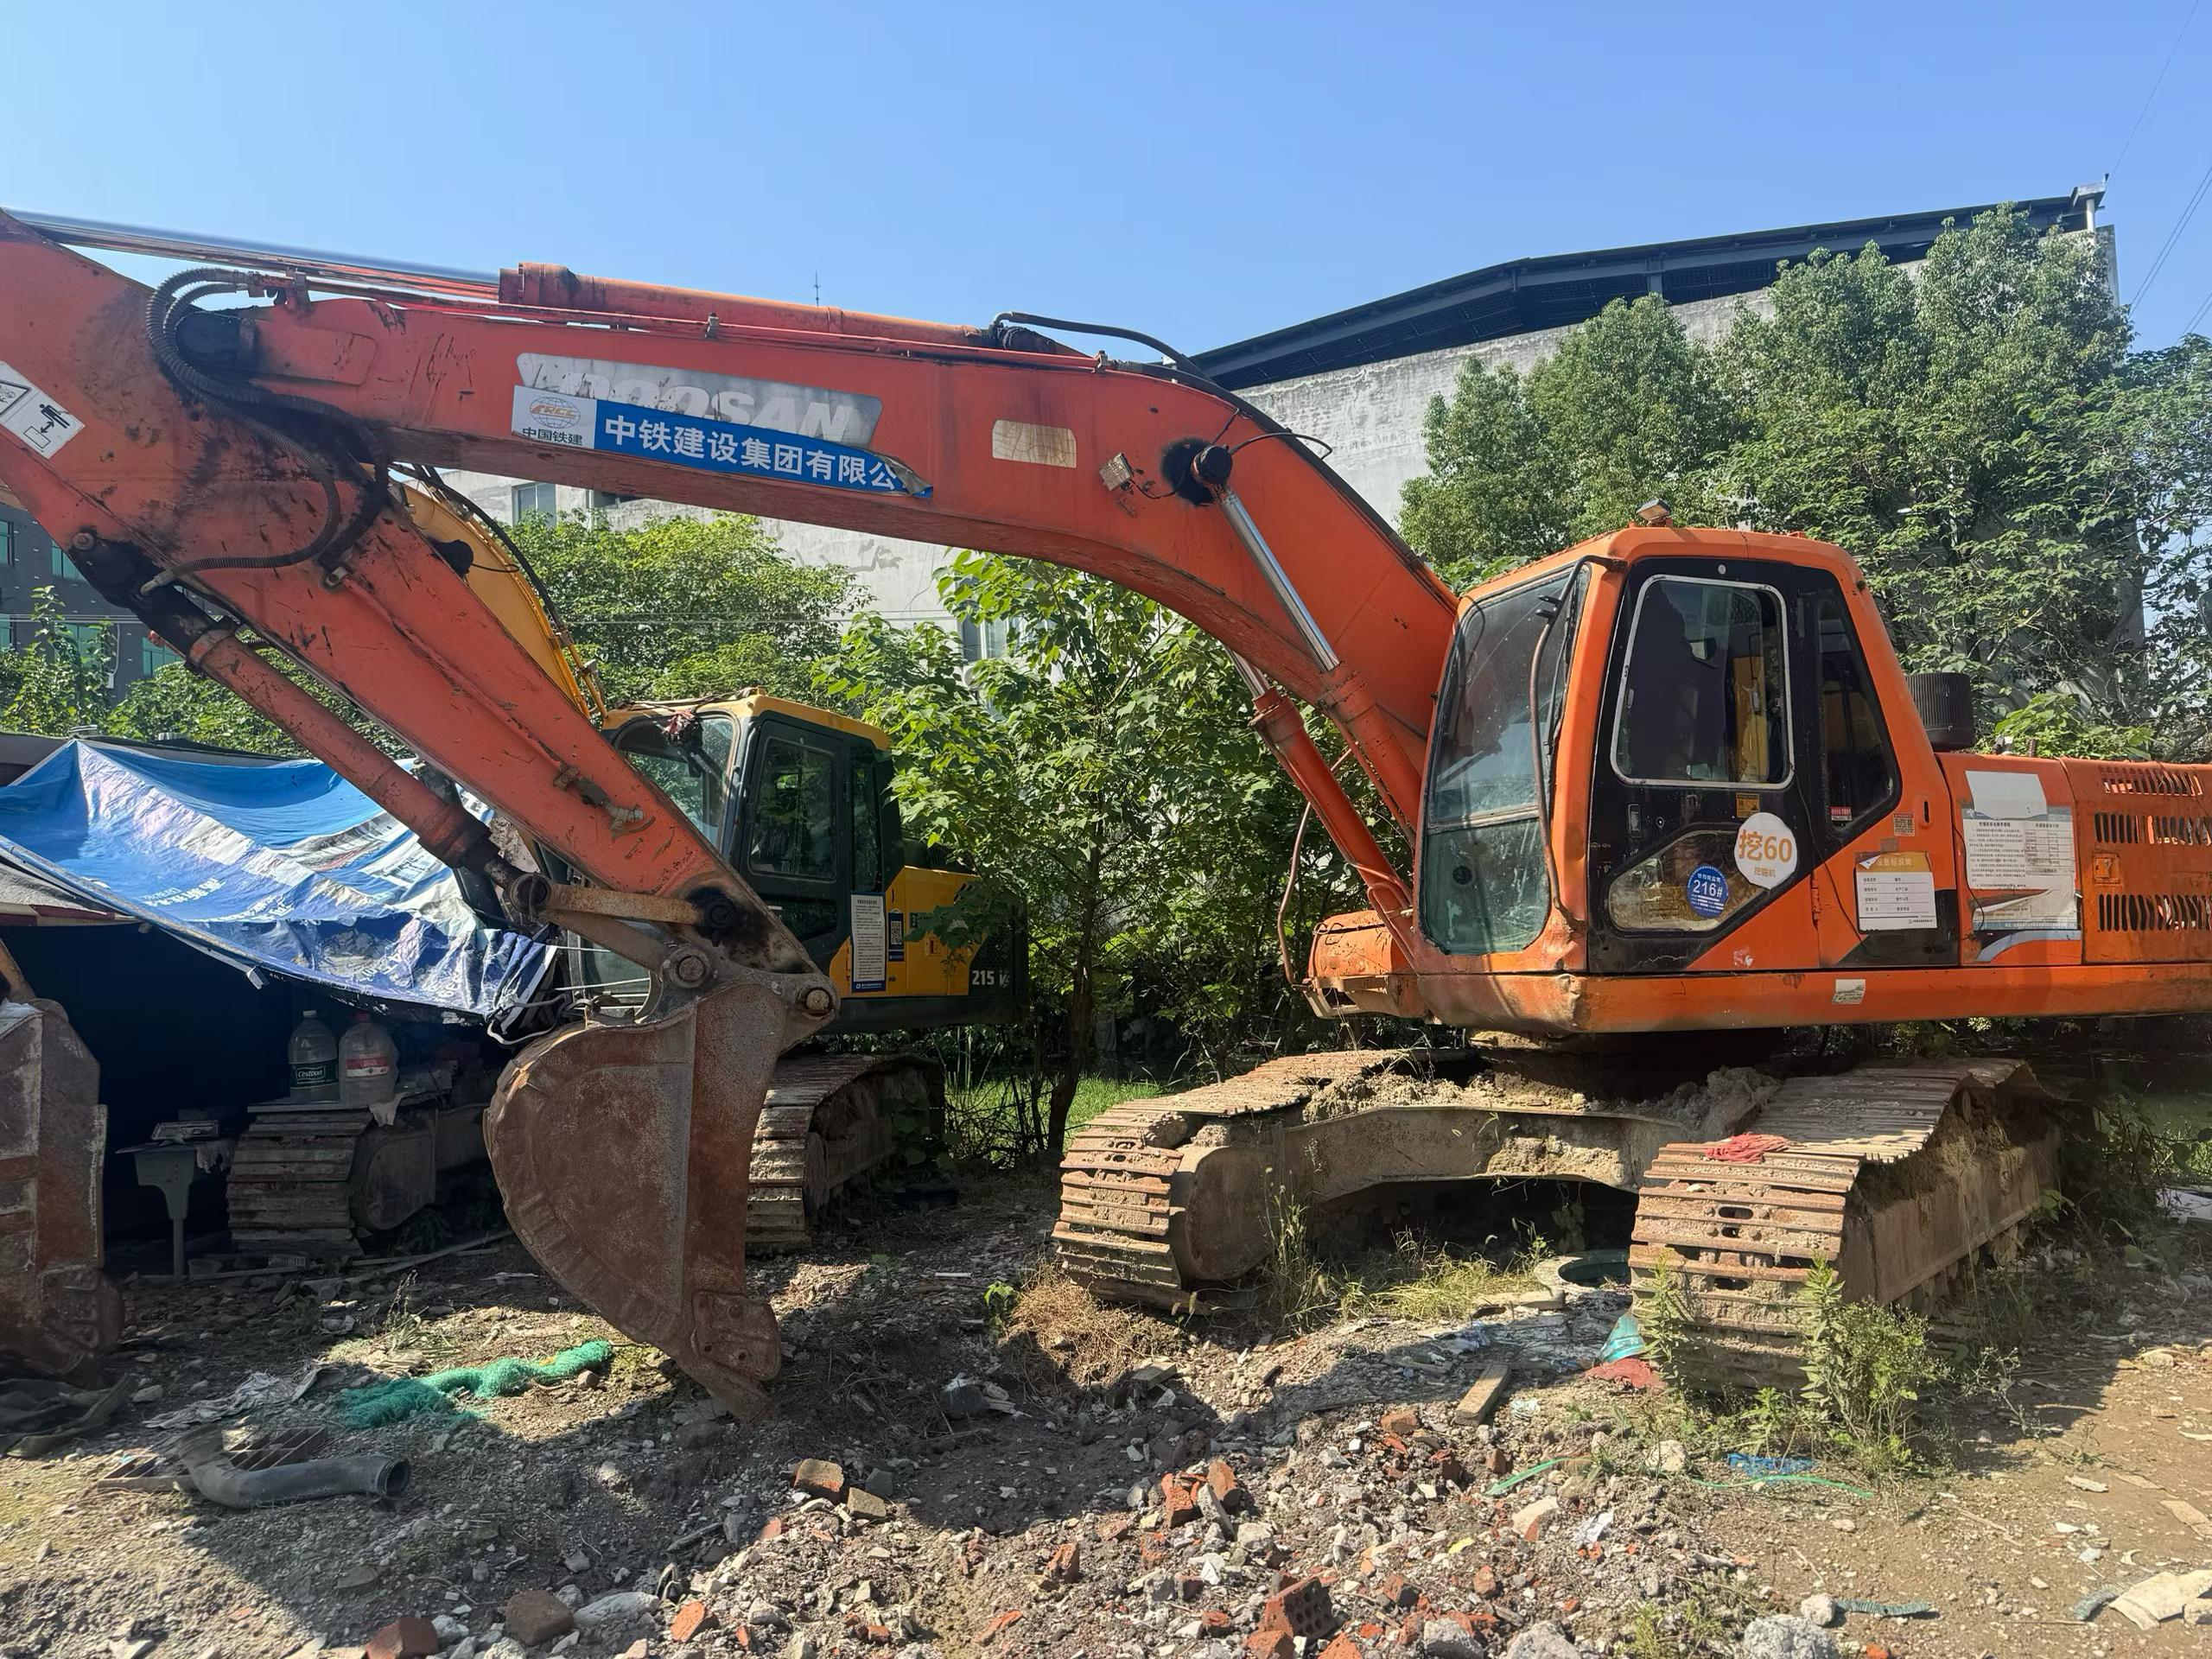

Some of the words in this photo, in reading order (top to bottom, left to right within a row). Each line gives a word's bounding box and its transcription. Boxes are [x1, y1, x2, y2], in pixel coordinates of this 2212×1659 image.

[522, 427, 583, 446] 中国铁建
[605, 414, 923, 494] 中铁建设集团有限公
[1738, 830, 1793, 863] 挖60
[1693, 880, 1724, 898] 216#
[972, 969, 995, 985] 215
